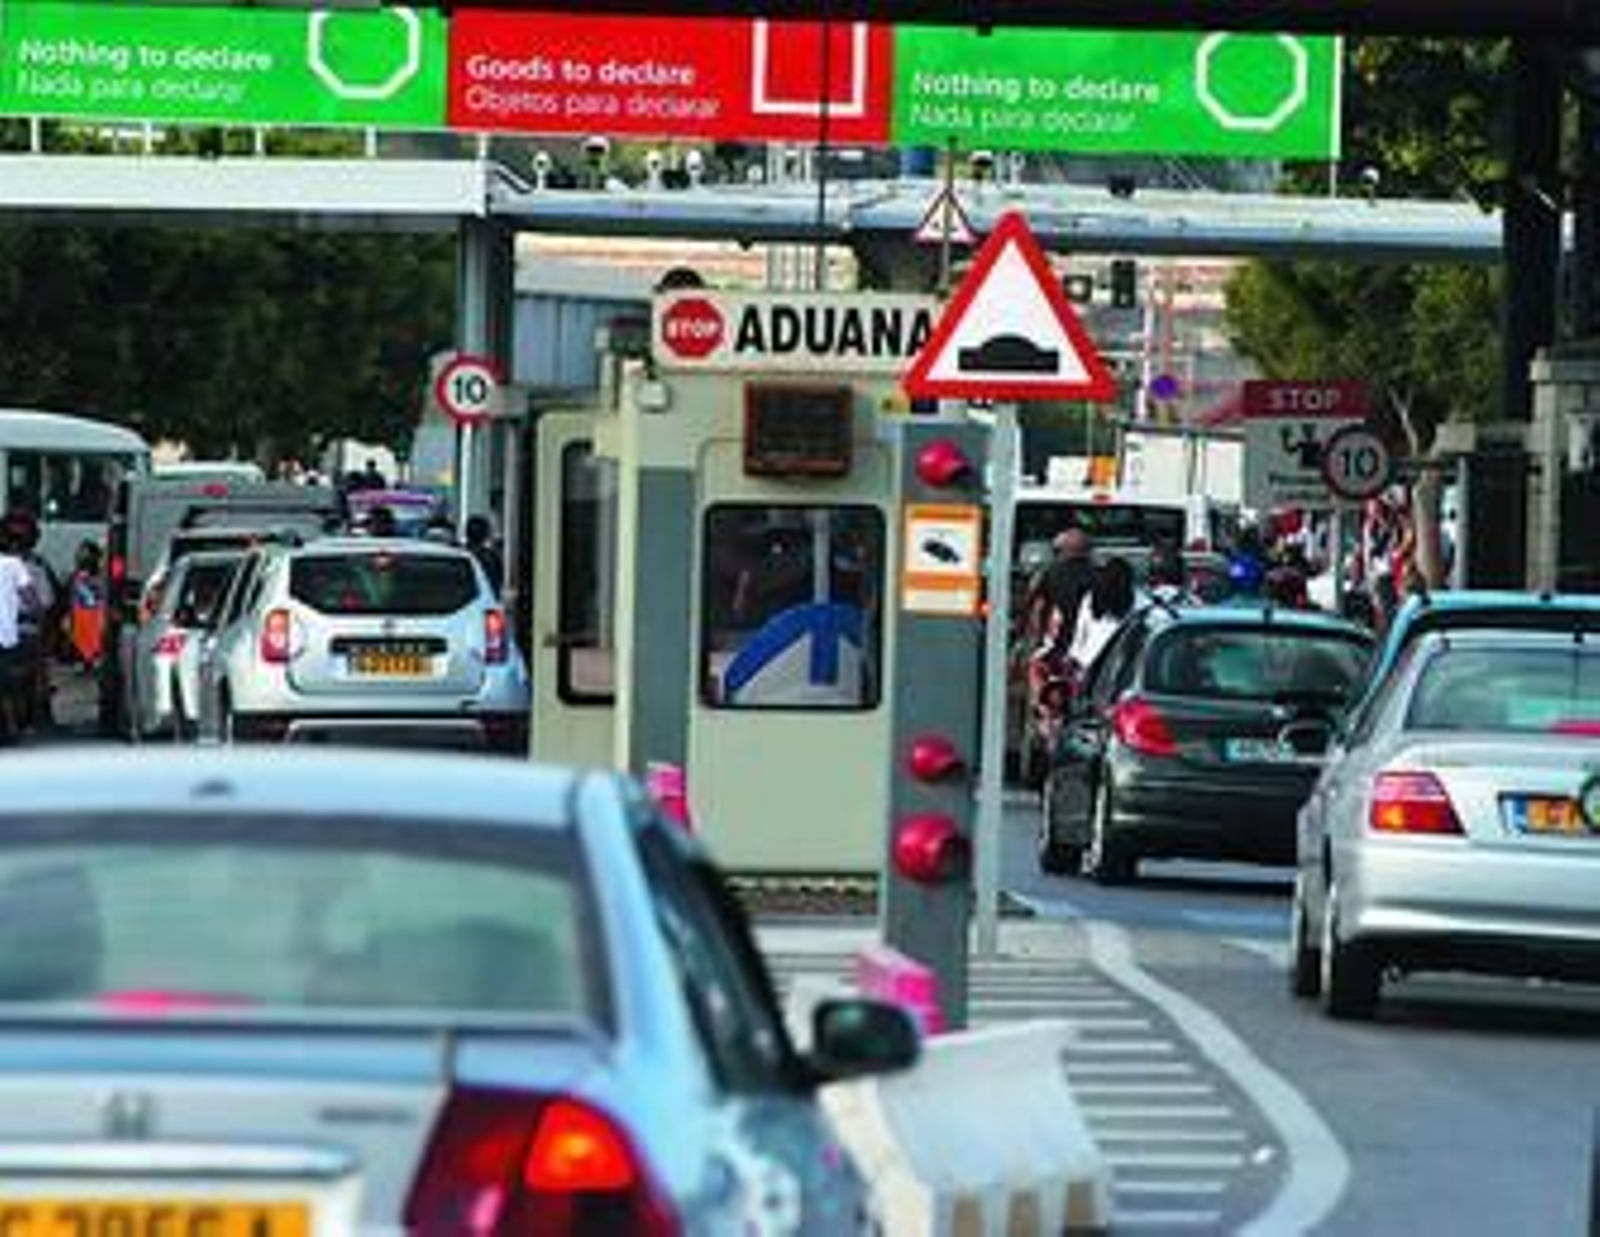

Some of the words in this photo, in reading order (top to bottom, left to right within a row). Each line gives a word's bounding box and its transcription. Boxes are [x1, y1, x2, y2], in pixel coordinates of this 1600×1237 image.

[20, 39, 131, 73] Nothing
[140, 45, 166, 67] to
[174, 45, 274, 71] declare
[466, 54, 552, 81] Goods
[561, 59, 590, 82] to
[599, 59, 695, 85] declare
[17, 70, 84, 97] Nada
[90, 78, 146, 103] para
[151, 79, 248, 104] declarar
[911, 71, 1021, 103] Nothing
[1029, 74, 1057, 99] to
[1064, 74, 1160, 103] declare
[566, 93, 619, 117] para
[627, 91, 720, 118] declarar
[910, 102, 973, 128] Nada
[982, 108, 1035, 134] para
[1041, 107, 1136, 133] declarar
[666, 316, 719, 339] STOP
[735, 305, 933, 356] ADUANA
[453, 374, 487, 405] 10
[1269, 389, 1341, 410] STOP
[1337, 446, 1379, 477] 10
